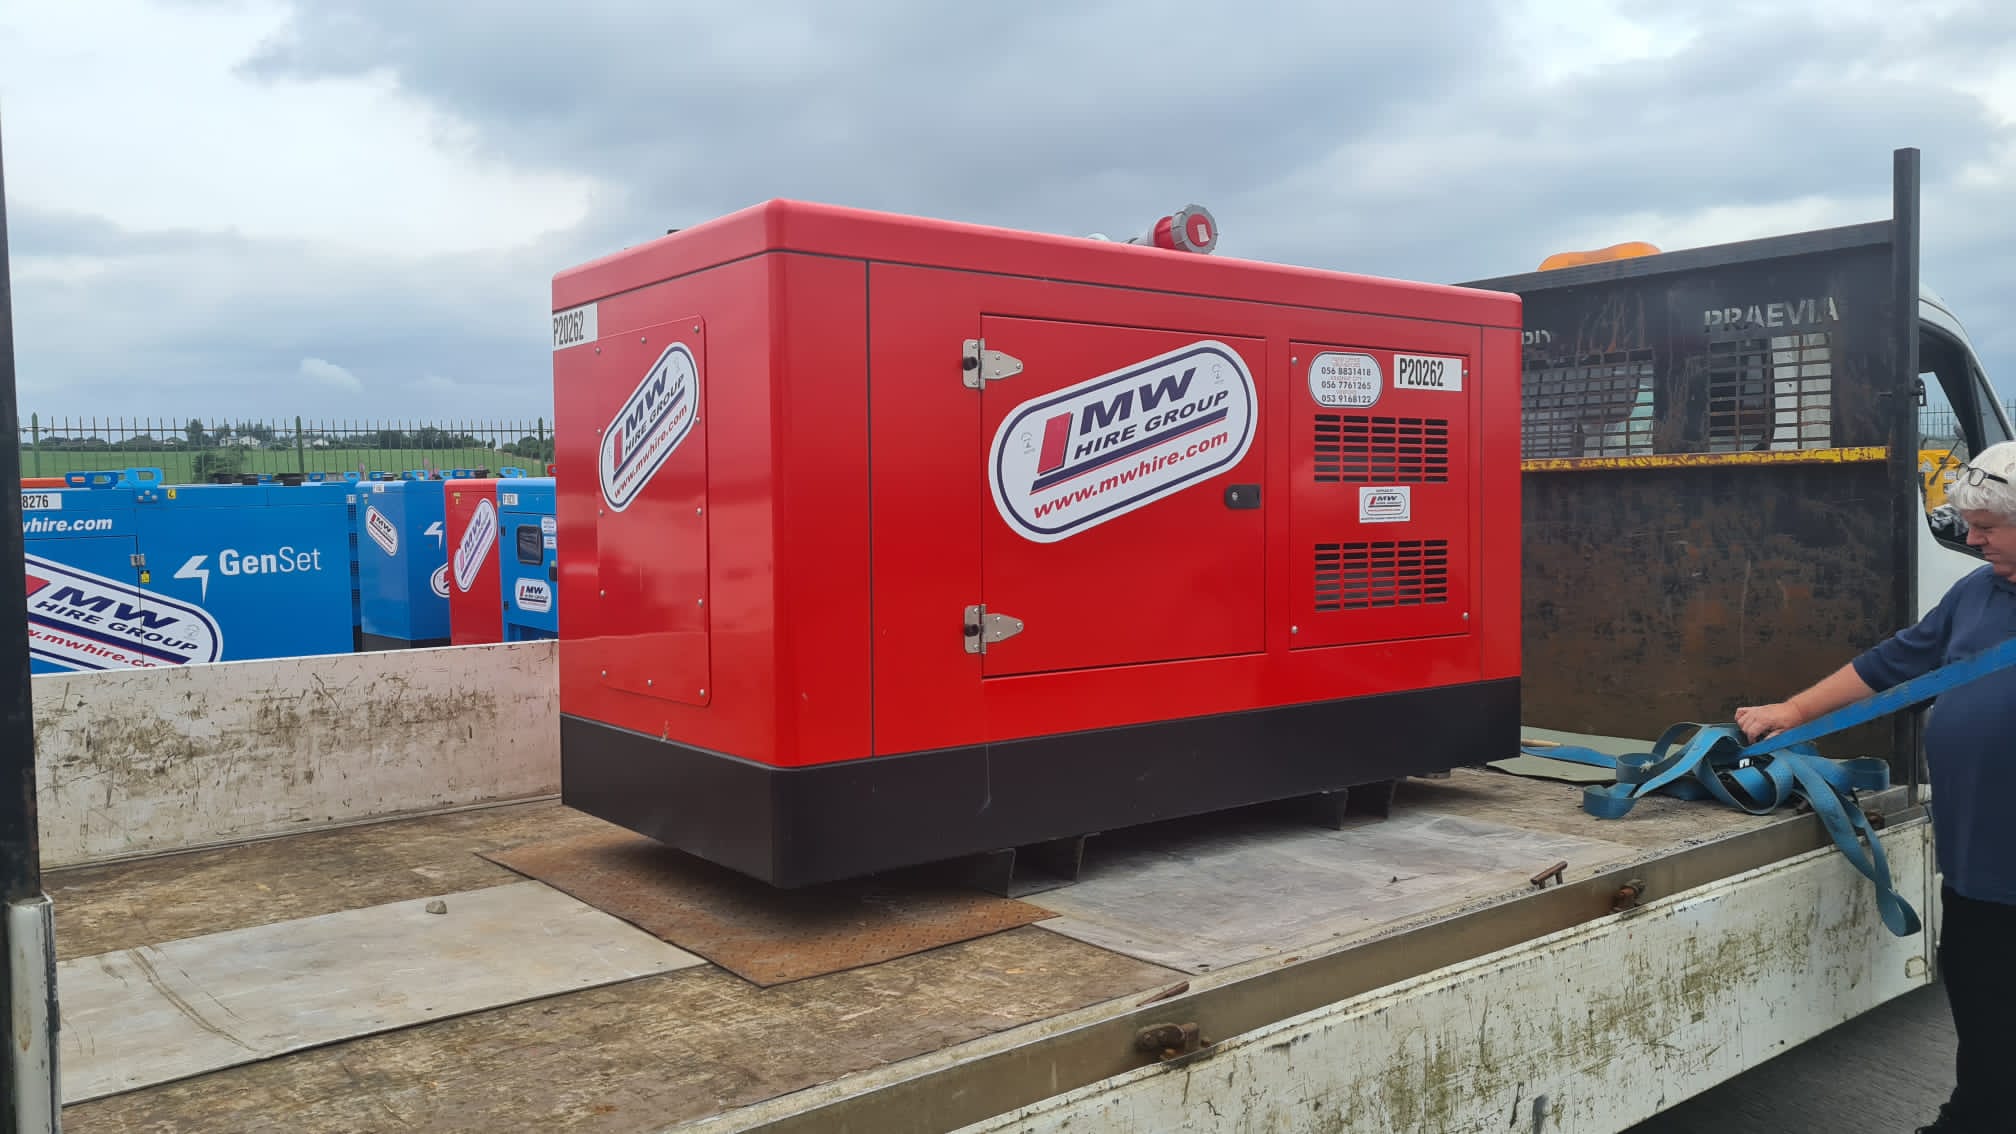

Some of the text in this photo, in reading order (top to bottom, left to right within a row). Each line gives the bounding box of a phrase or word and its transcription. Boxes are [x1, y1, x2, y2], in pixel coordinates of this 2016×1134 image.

[553, 310, 584, 347] P20262
[1321, 366, 1337, 375] 056
[1321, 380, 1371, 390] 056 7761265
[1399, 358, 1444, 387] P20262
[625, 367, 668, 438] MW
[625, 373, 685, 455] HIRE GROUP
[1079, 367, 1197, 436] MW
[1321, 394, 1337, 403] 053
[1073, 390, 1229, 460] HIRE GROUP
[614, 404, 687, 499] www.mwhire.com
[1033, 431, 1228, 519] www.mwhire.com
[22, 495, 49, 509] 8276
[219, 546, 322, 576] GenSet
[49, 585, 179, 630] MW
[525, 585, 543, 594] MW
[34, 600, 199, 651] HIRE GROUP
